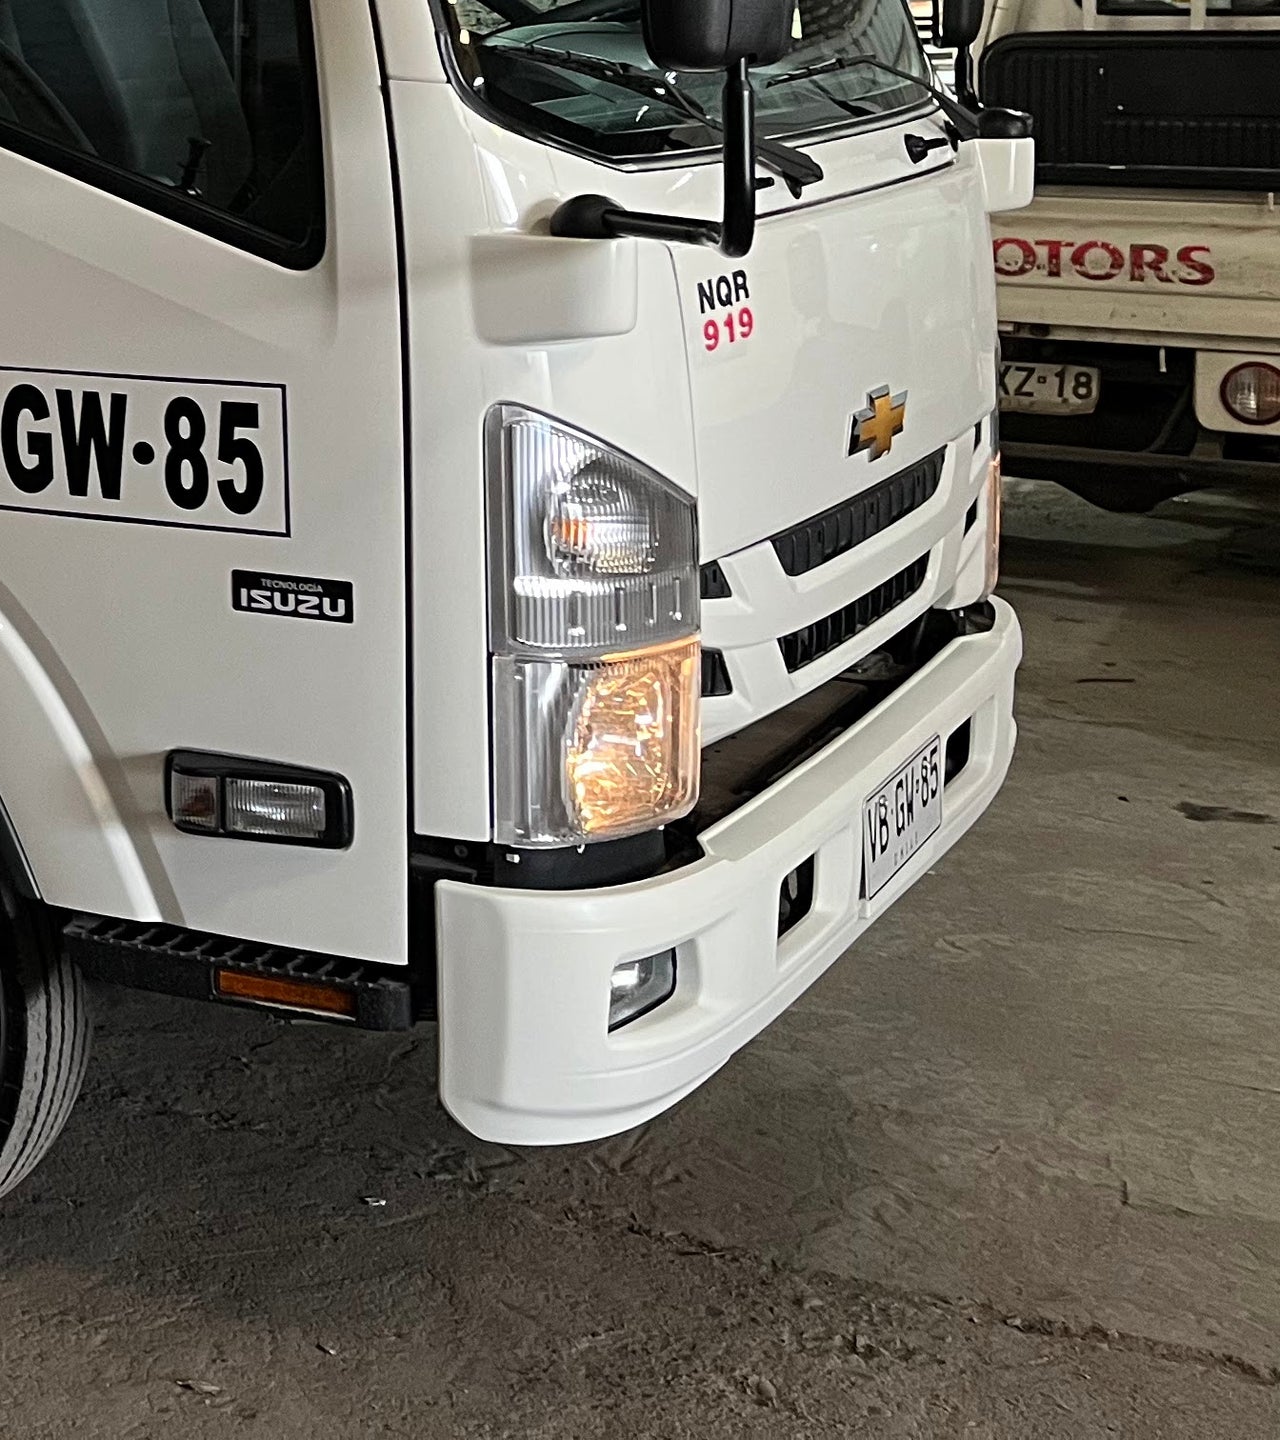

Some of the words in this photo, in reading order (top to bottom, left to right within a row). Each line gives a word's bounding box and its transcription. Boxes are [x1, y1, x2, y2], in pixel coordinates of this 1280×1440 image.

[697, 269, 750, 314] NQR
[703, 307, 754, 352] 919
[240, 587, 346, 617] ISUZU
